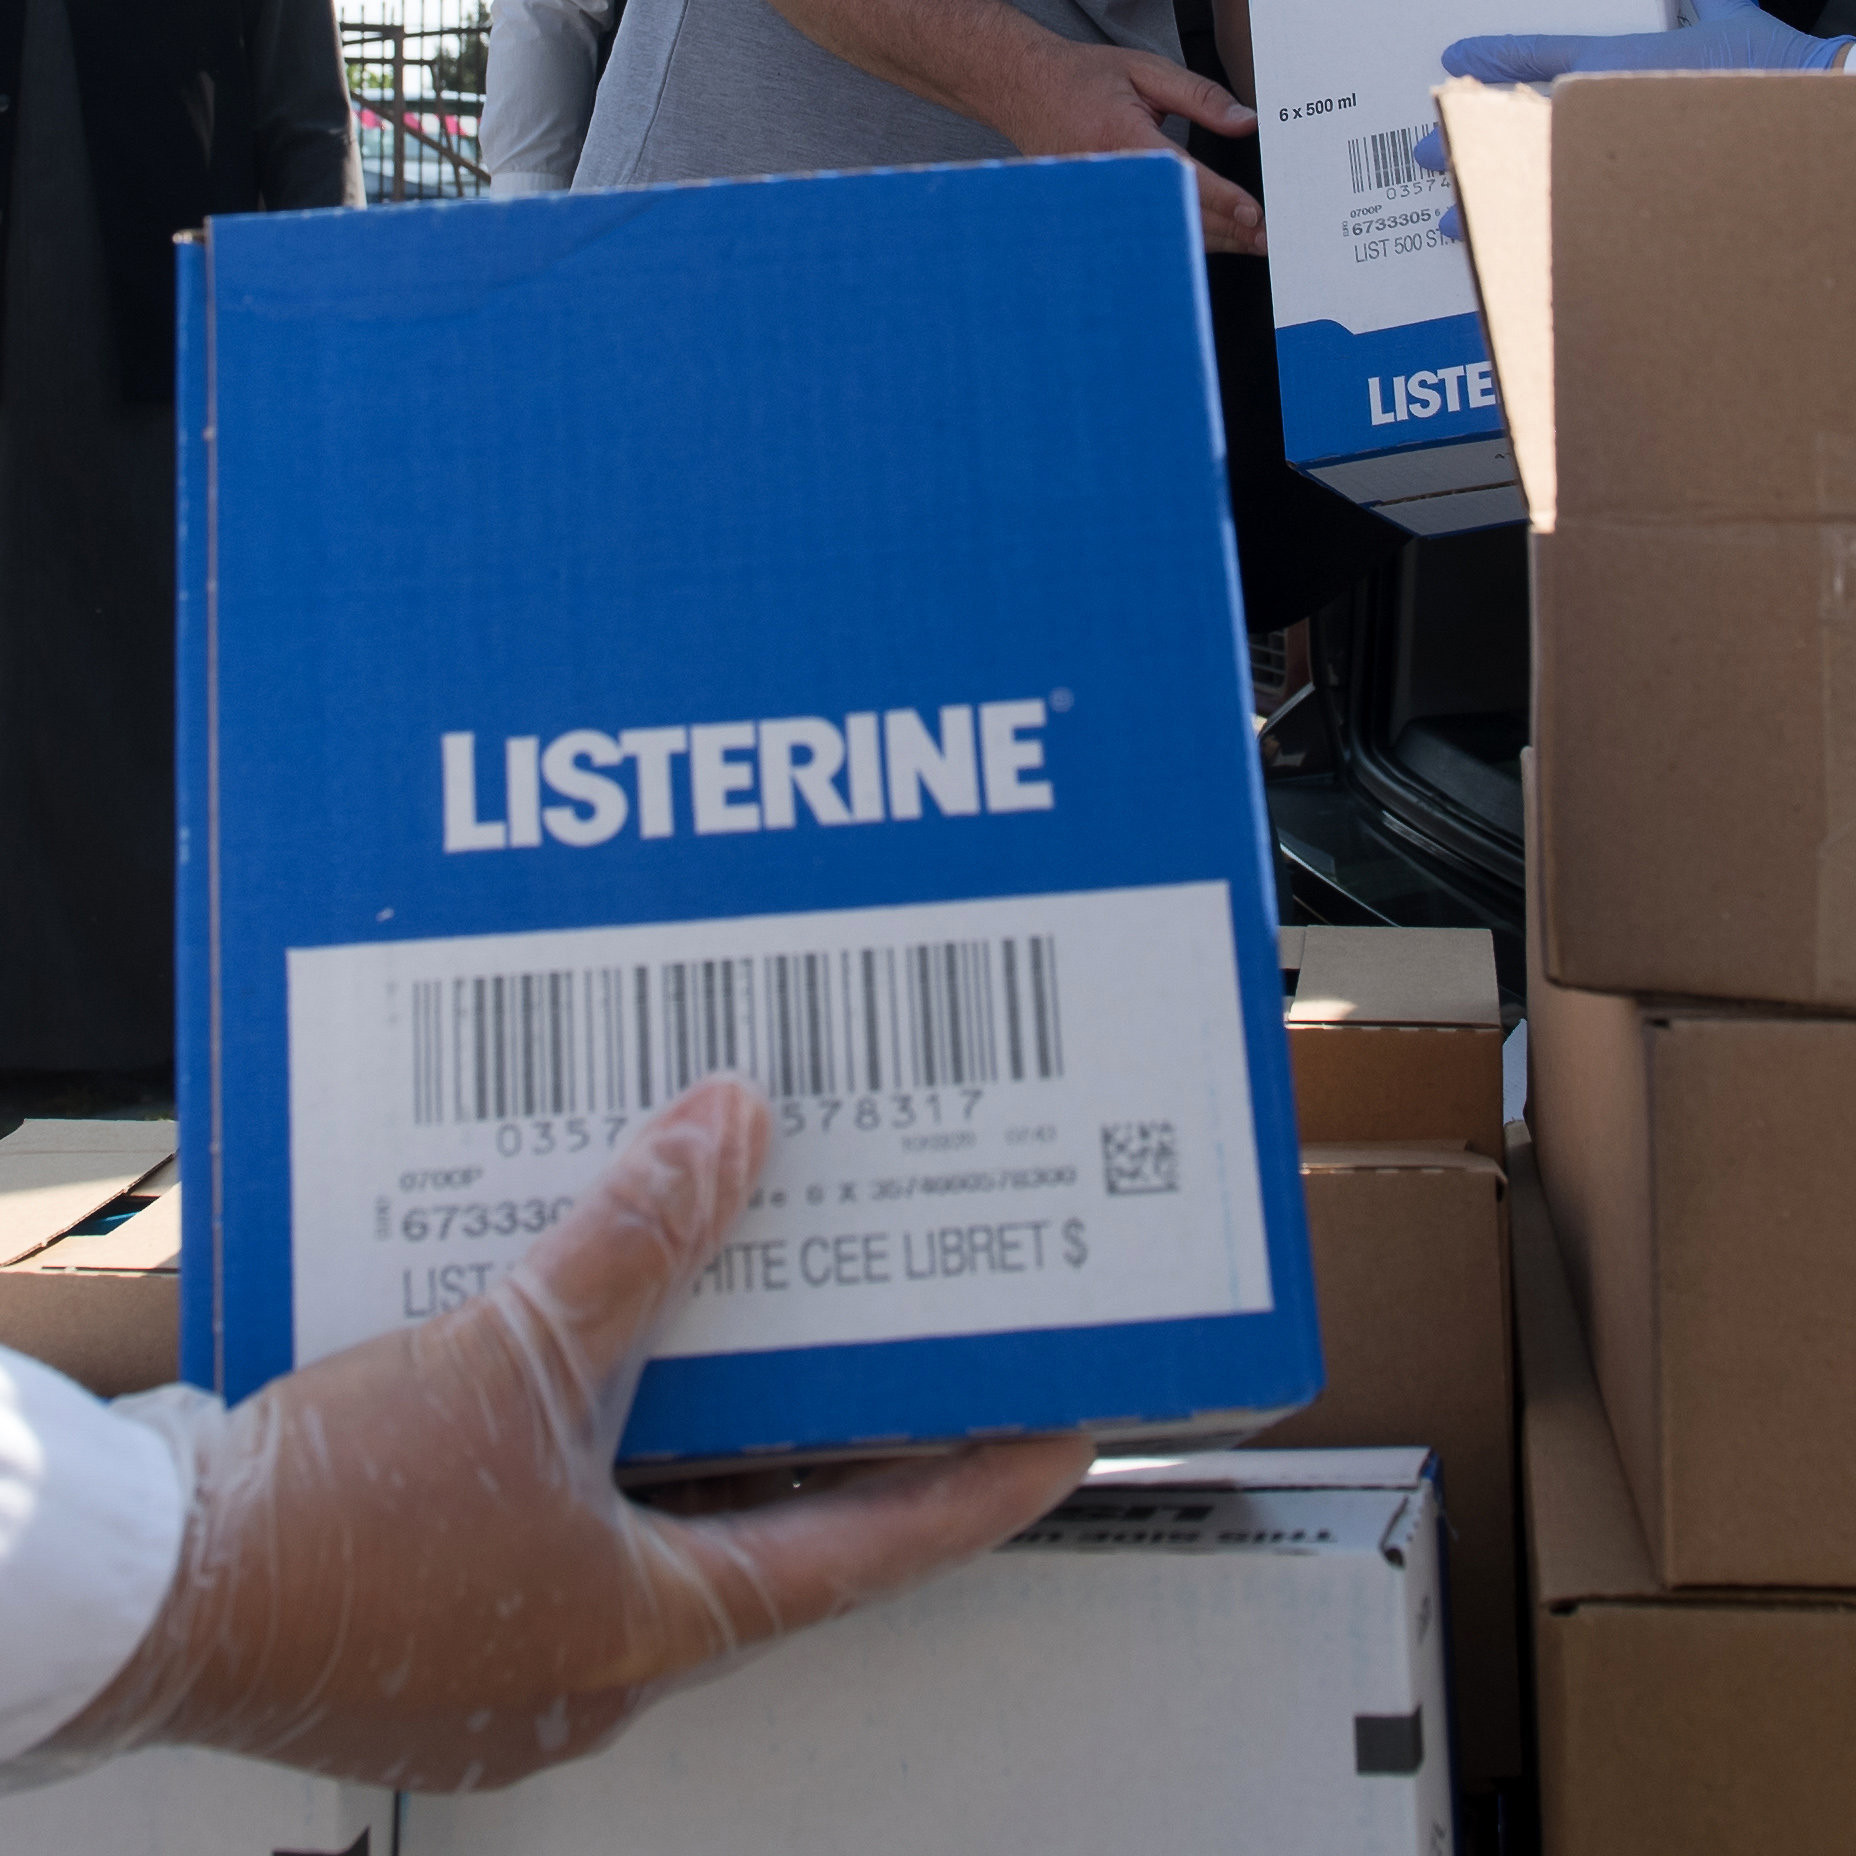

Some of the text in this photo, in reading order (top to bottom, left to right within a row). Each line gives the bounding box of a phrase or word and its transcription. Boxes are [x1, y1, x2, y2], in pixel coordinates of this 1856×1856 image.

[1279, 108, 1289, 122] 6
[1306, 98, 1333, 116] 500
[1338, 93, 1357, 110] ml
[1386, 179, 1451, 200] 03574
[1350, 204, 1382, 218] 0700P
[1352, 208, 1432, 236] 6733305
[1354, 228, 1456, 263] LIST 500 ST.
[1368, 360, 1496, 425] LISTE
[442, 699, 1054, 854] LISTERINE
[401, 1196, 574, 1243] 67333
[799, 1232, 892, 1288] CEE
[904, 1220, 1051, 1281] LIBRET
[401, 1262, 494, 1319] LIST
